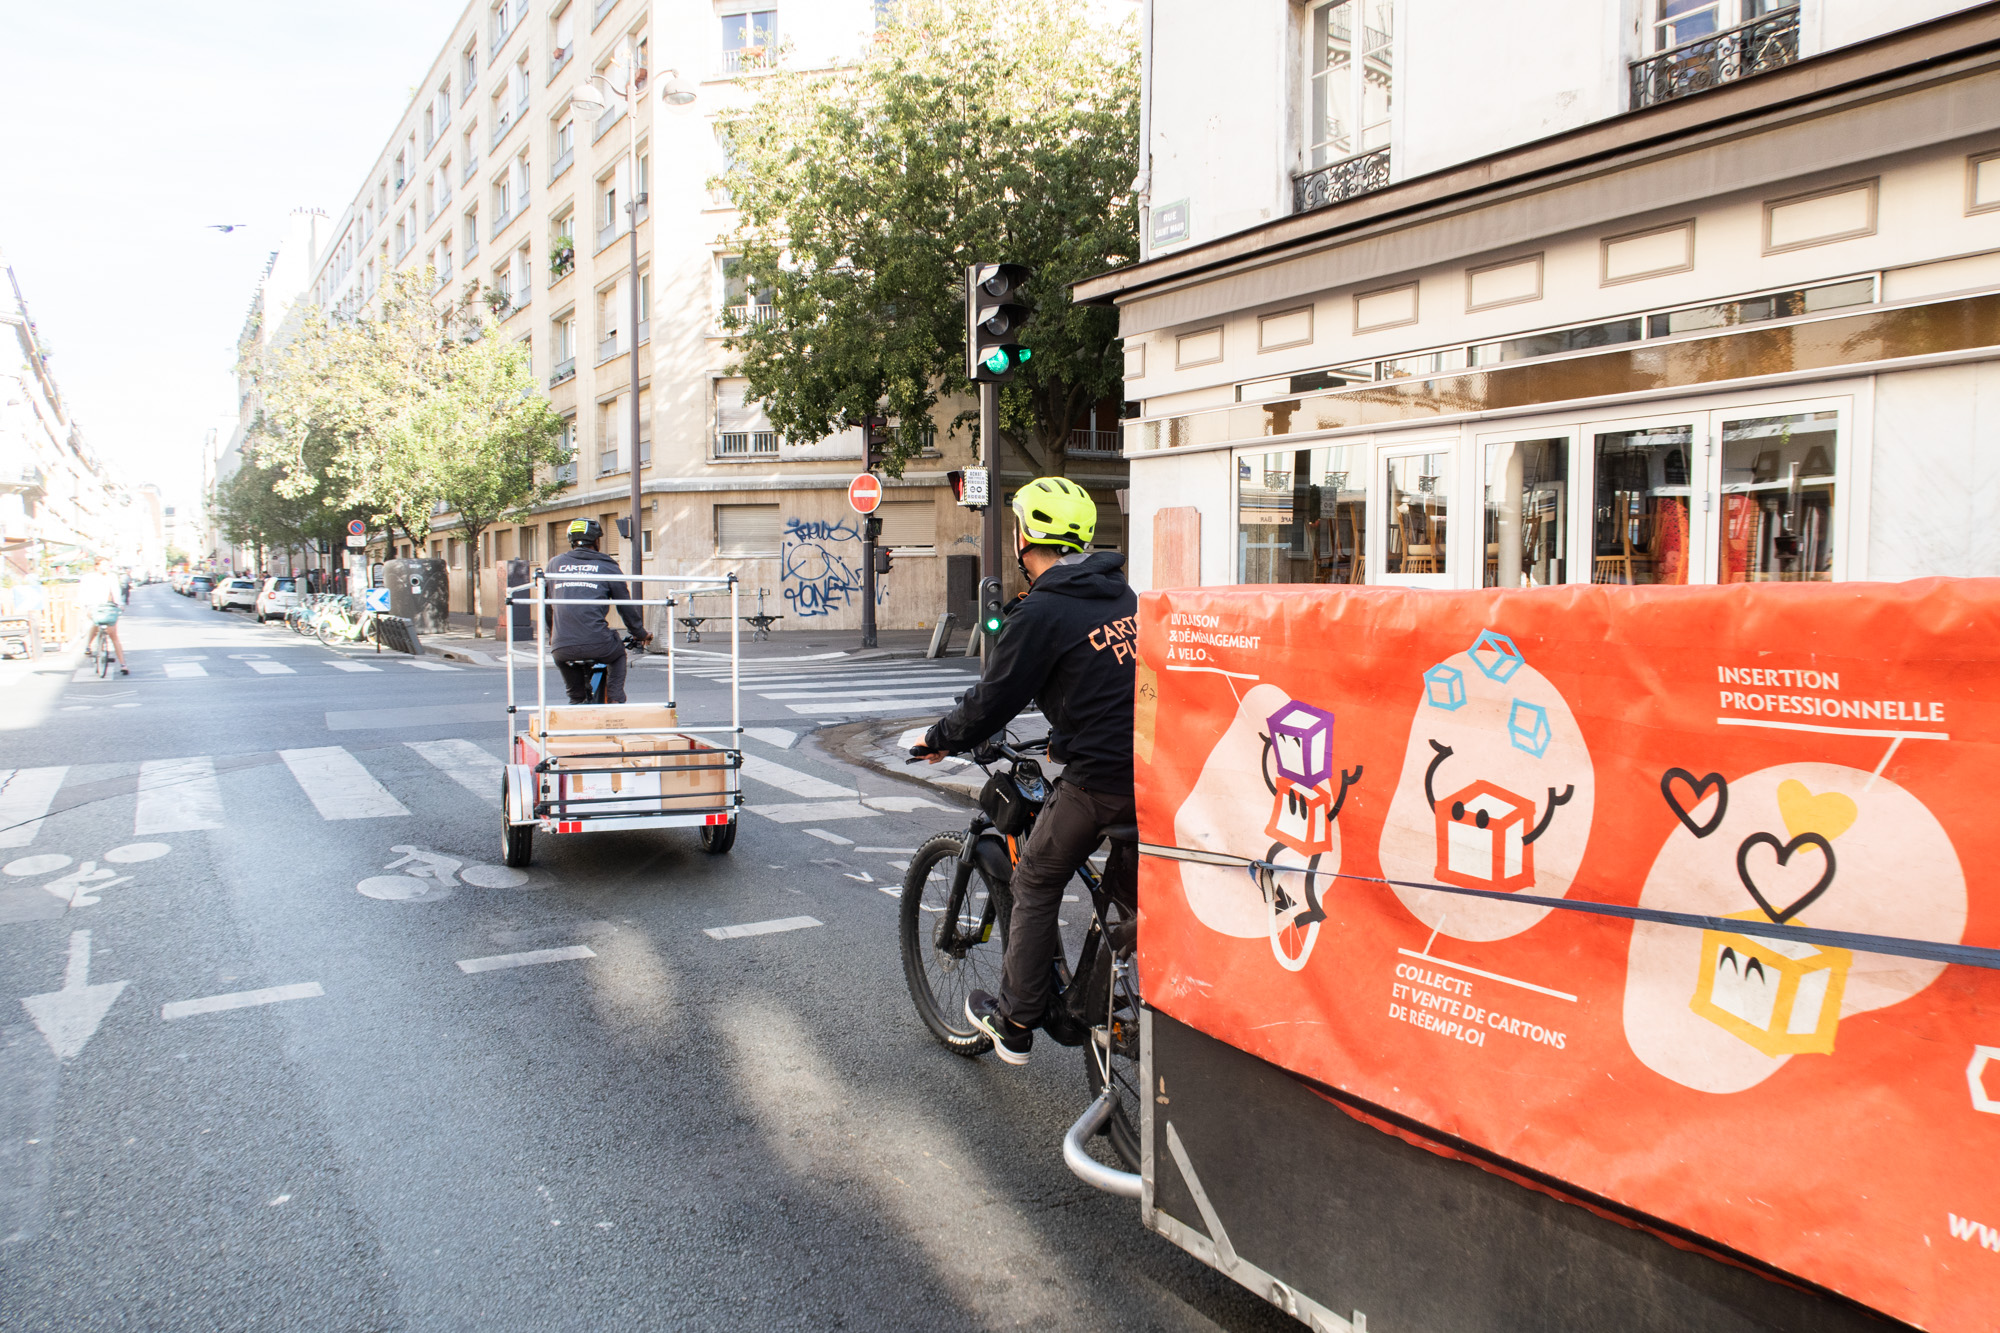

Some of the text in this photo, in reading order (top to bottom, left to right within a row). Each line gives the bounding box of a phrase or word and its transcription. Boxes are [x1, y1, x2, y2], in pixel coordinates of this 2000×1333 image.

[1163, 210, 1177, 223] RUE
[563, 581, 599, 590] FORMATION
[1171, 613, 1219, 628] LIVRAISON
[1717, 666, 1840, 690] INSERTION
[1720, 691, 1946, 722] PROFESSIONNELLE
[1396, 963, 1473, 998] COLLECTE
[1388, 1002, 1486, 1047] DE RÉEMPLOI
[1392, 982, 1567, 1050] ET VENTE DE CARTONS
